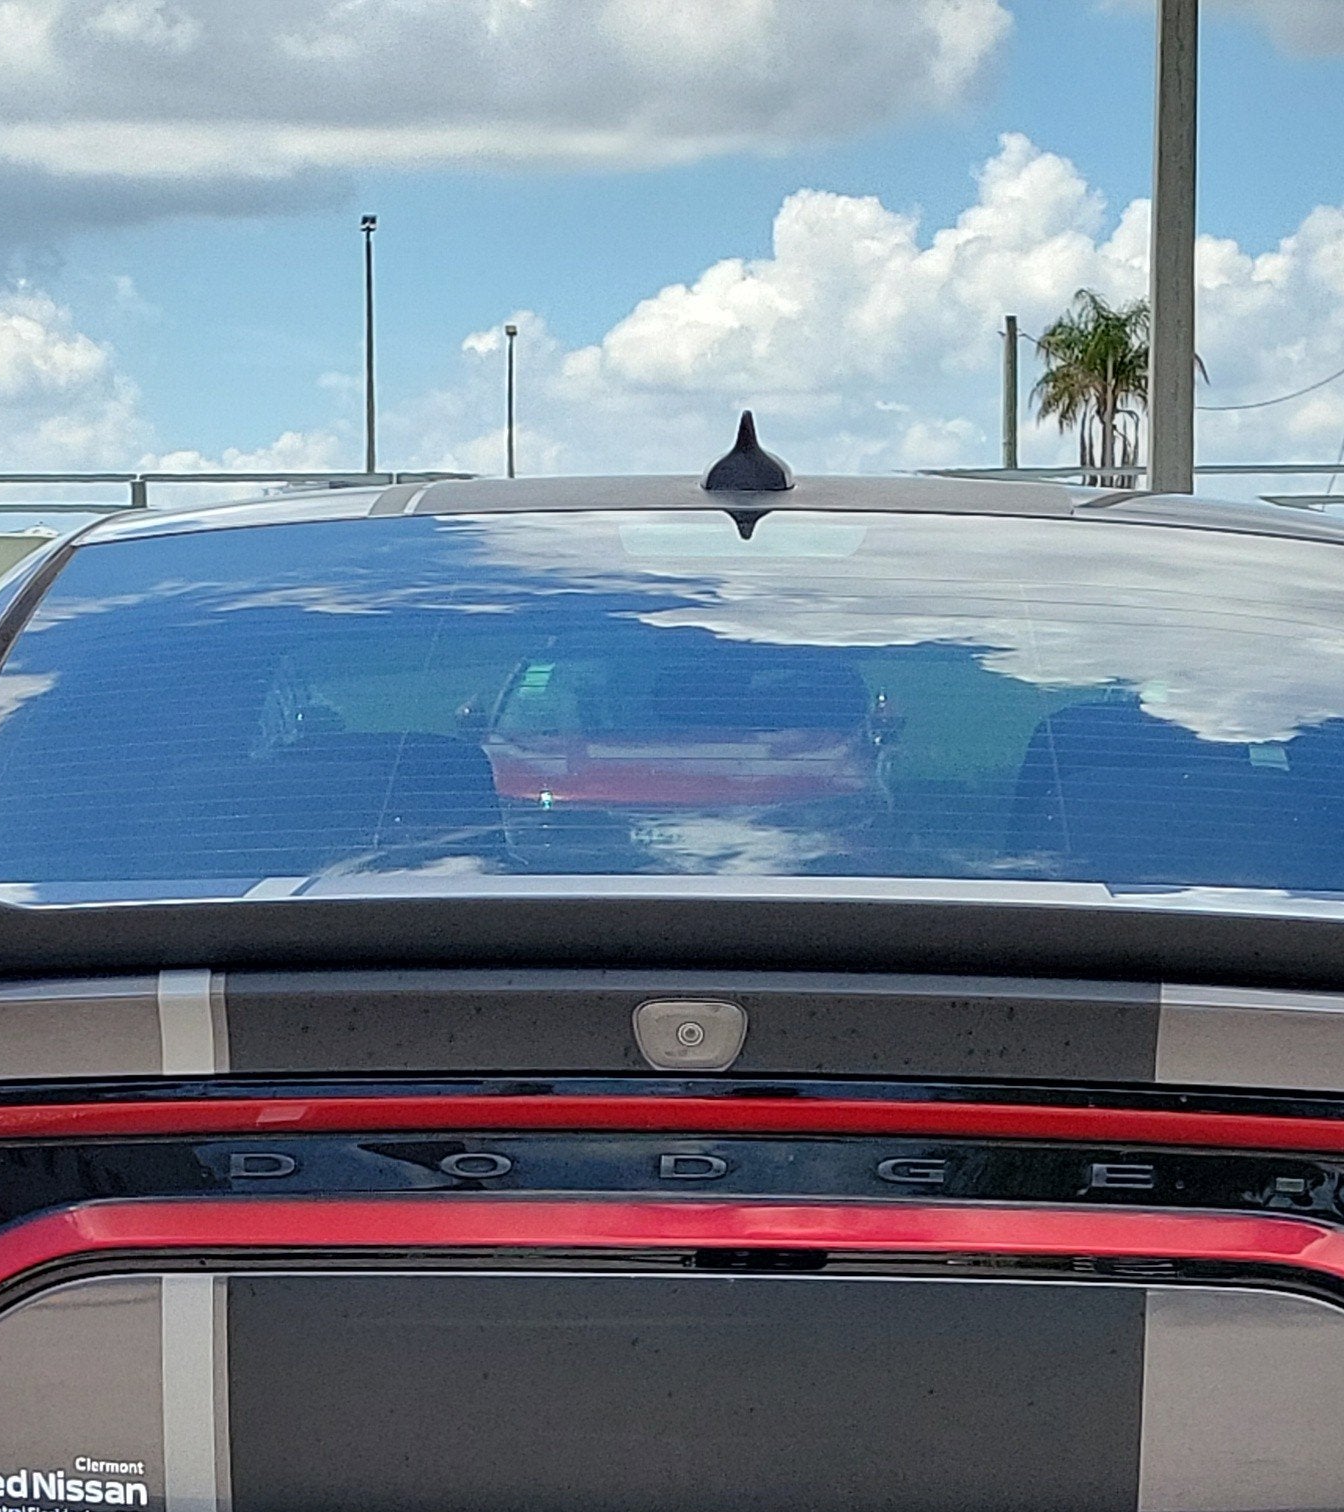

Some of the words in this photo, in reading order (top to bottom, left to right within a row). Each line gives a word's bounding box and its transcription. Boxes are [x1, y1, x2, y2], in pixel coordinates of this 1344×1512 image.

[229, 1151, 1154, 1191] DODGE
[75, 1456, 145, 1475] Clermont
[32, 1470, 148, 1506] Nissan
